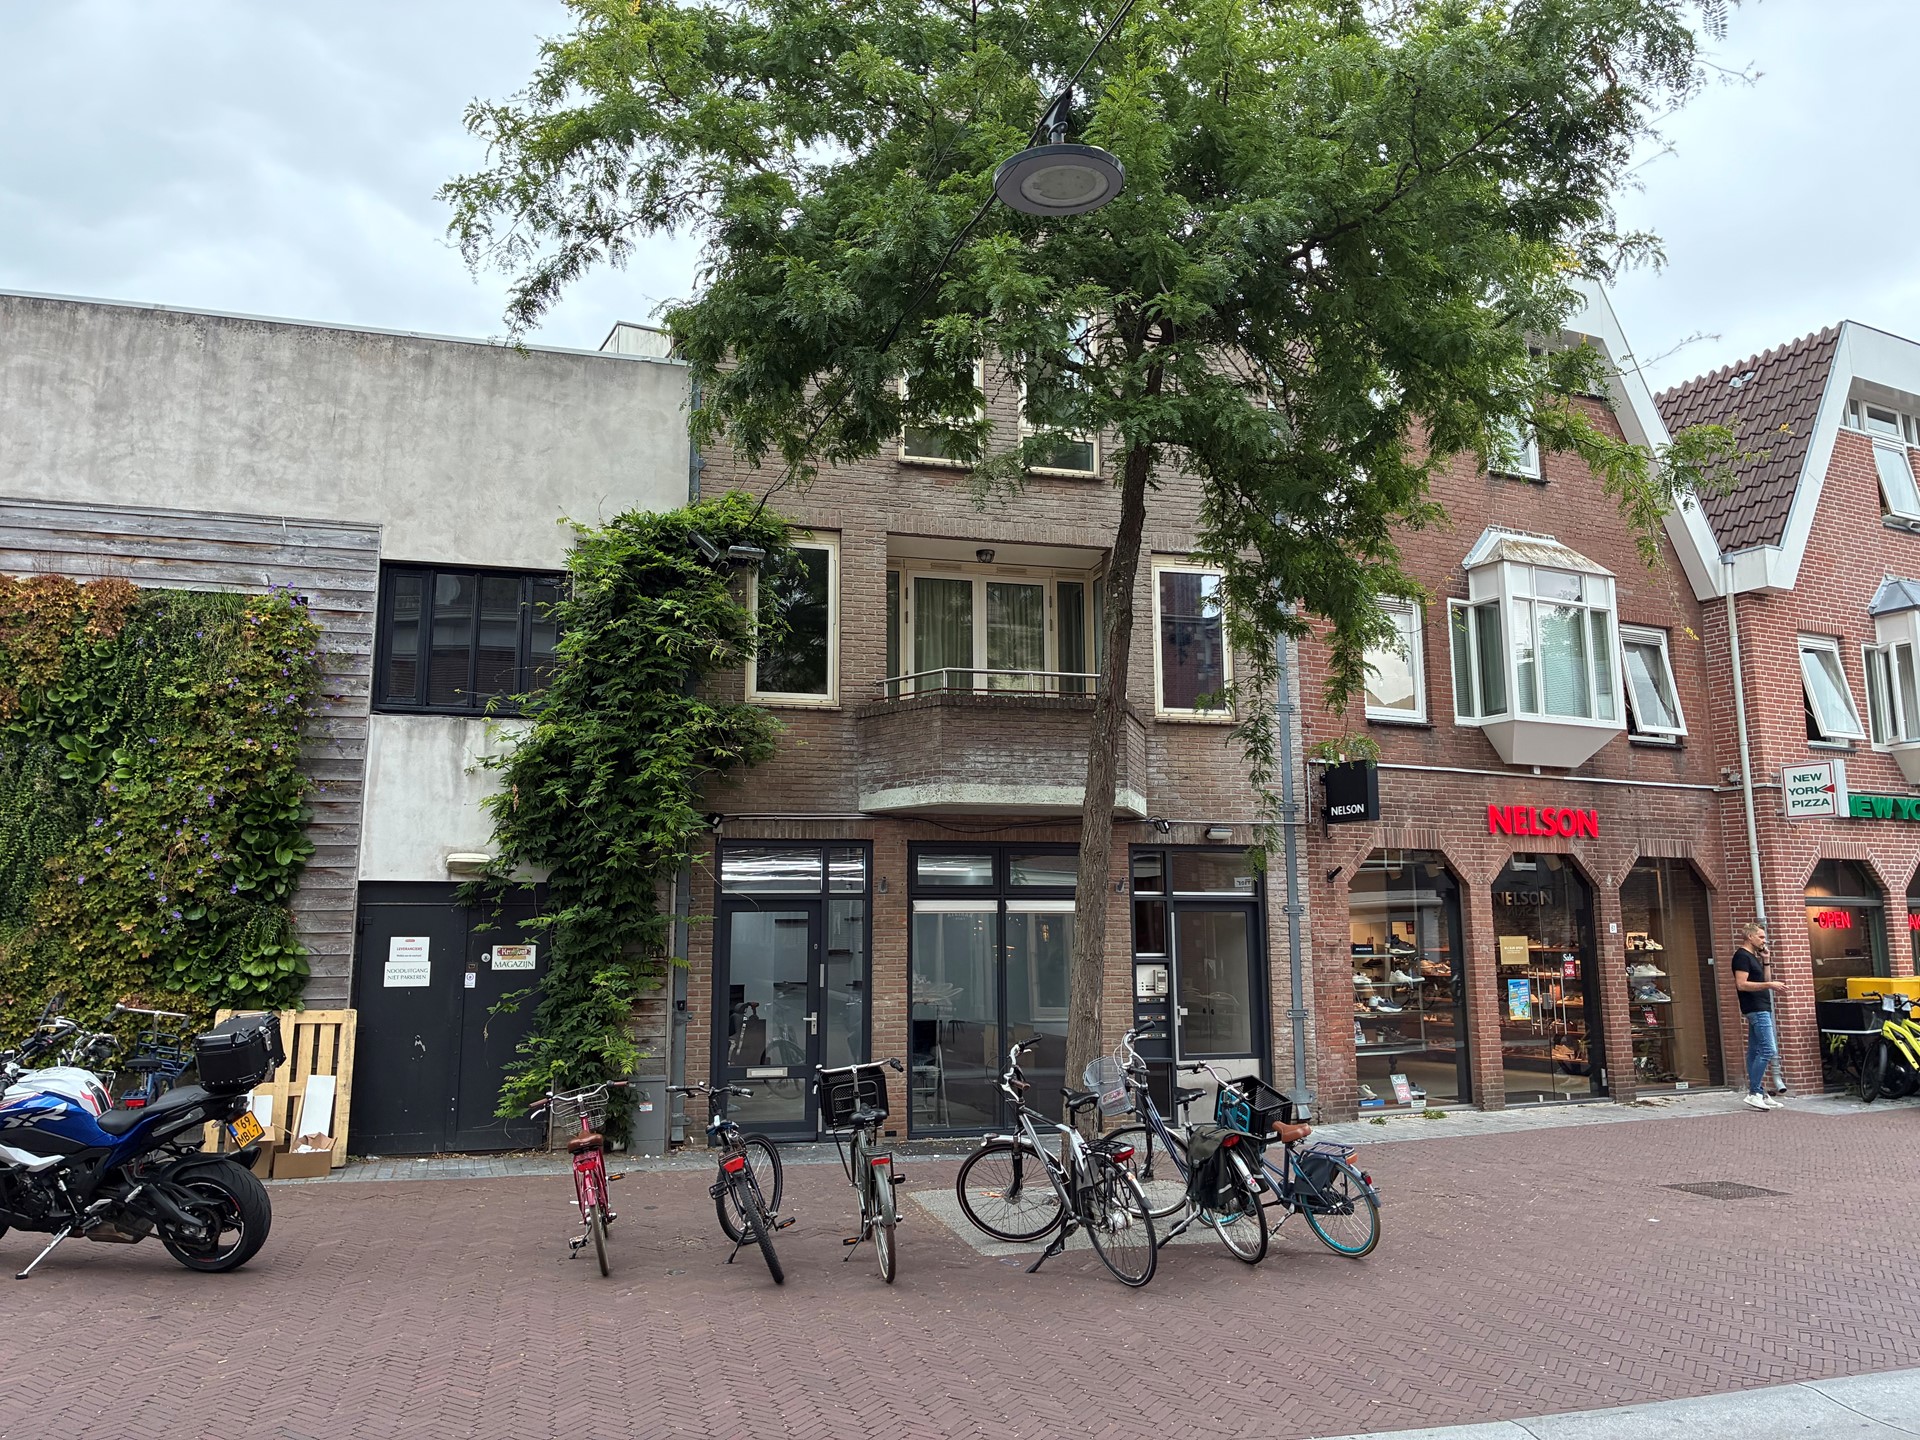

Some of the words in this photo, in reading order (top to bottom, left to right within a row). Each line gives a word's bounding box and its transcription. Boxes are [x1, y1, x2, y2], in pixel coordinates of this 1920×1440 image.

[1792, 772, 1822, 783] NEW
[1787, 784, 1829, 796] YORK
[1791, 798, 1831, 808] PIZZA
[1330, 803, 1365, 816] NELSON
[1487, 804, 1599, 838] NELSON
[1494, 890, 1553, 905] NELSON
[1818, 911, 1851, 928] OPEN
[1562, 953, 1575, 962] Sale
[493, 960, 534, 969] MAGAZIJN
[237, 1124, 259, 1146] MBL-7
